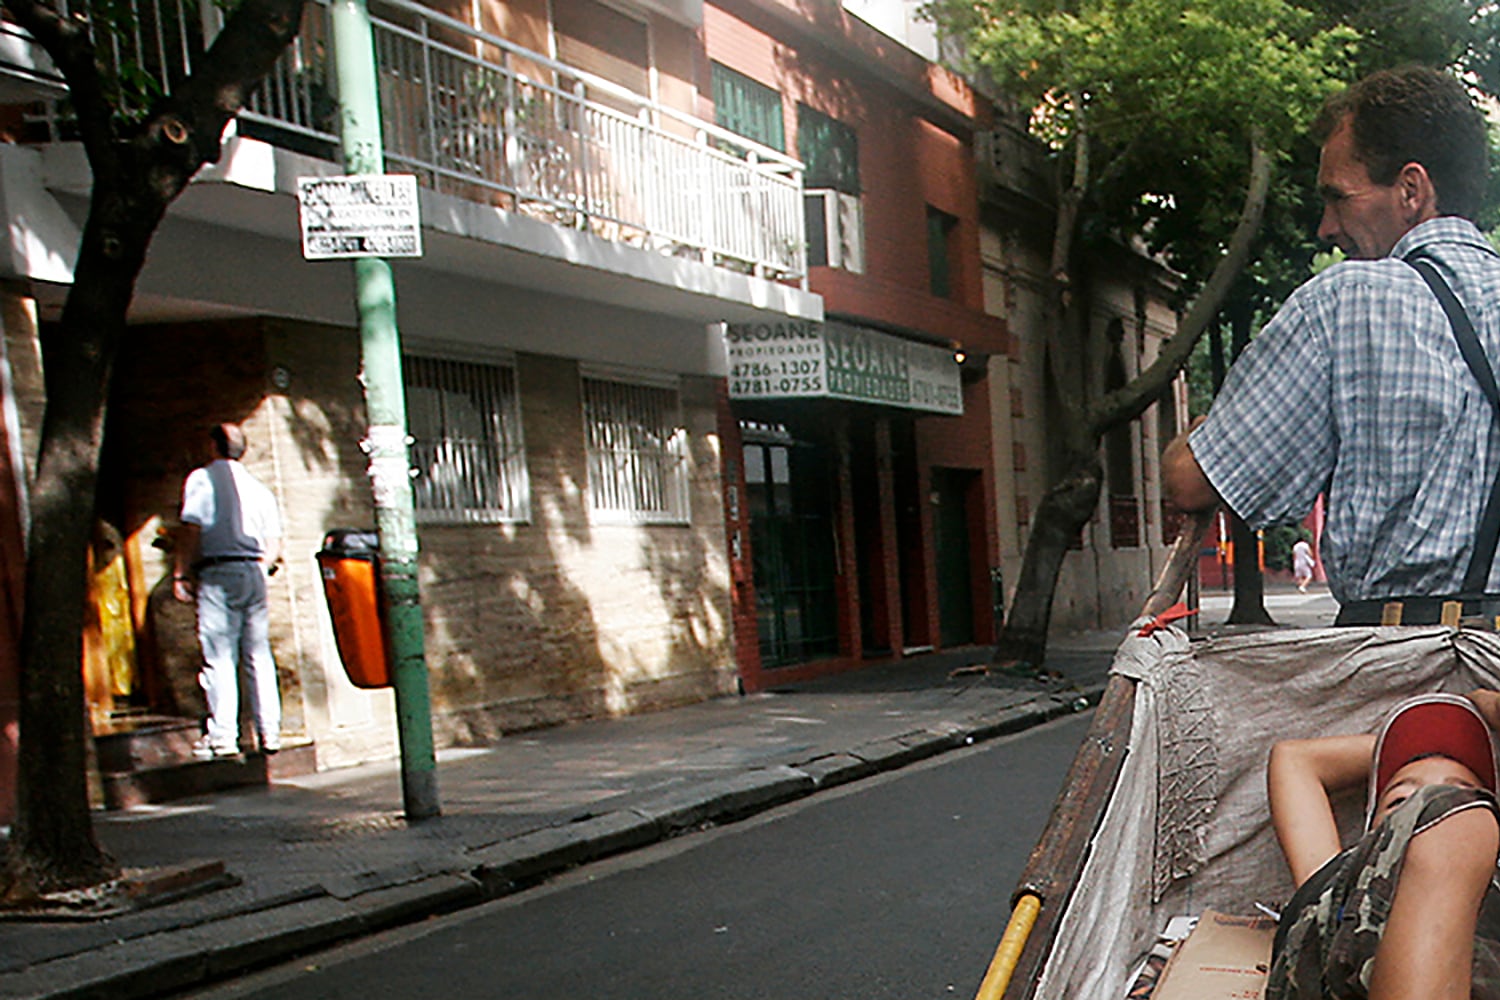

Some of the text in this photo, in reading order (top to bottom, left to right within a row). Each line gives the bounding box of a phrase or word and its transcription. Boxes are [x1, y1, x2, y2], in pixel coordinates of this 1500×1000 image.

[728, 322, 818, 343] SEOANE
[729, 344, 821, 357] PROPIEDADES
[827, 335, 907, 379] SEOANE
[731, 359, 820, 377] 4786-1307
[731, 376, 822, 394] 4781-0755
